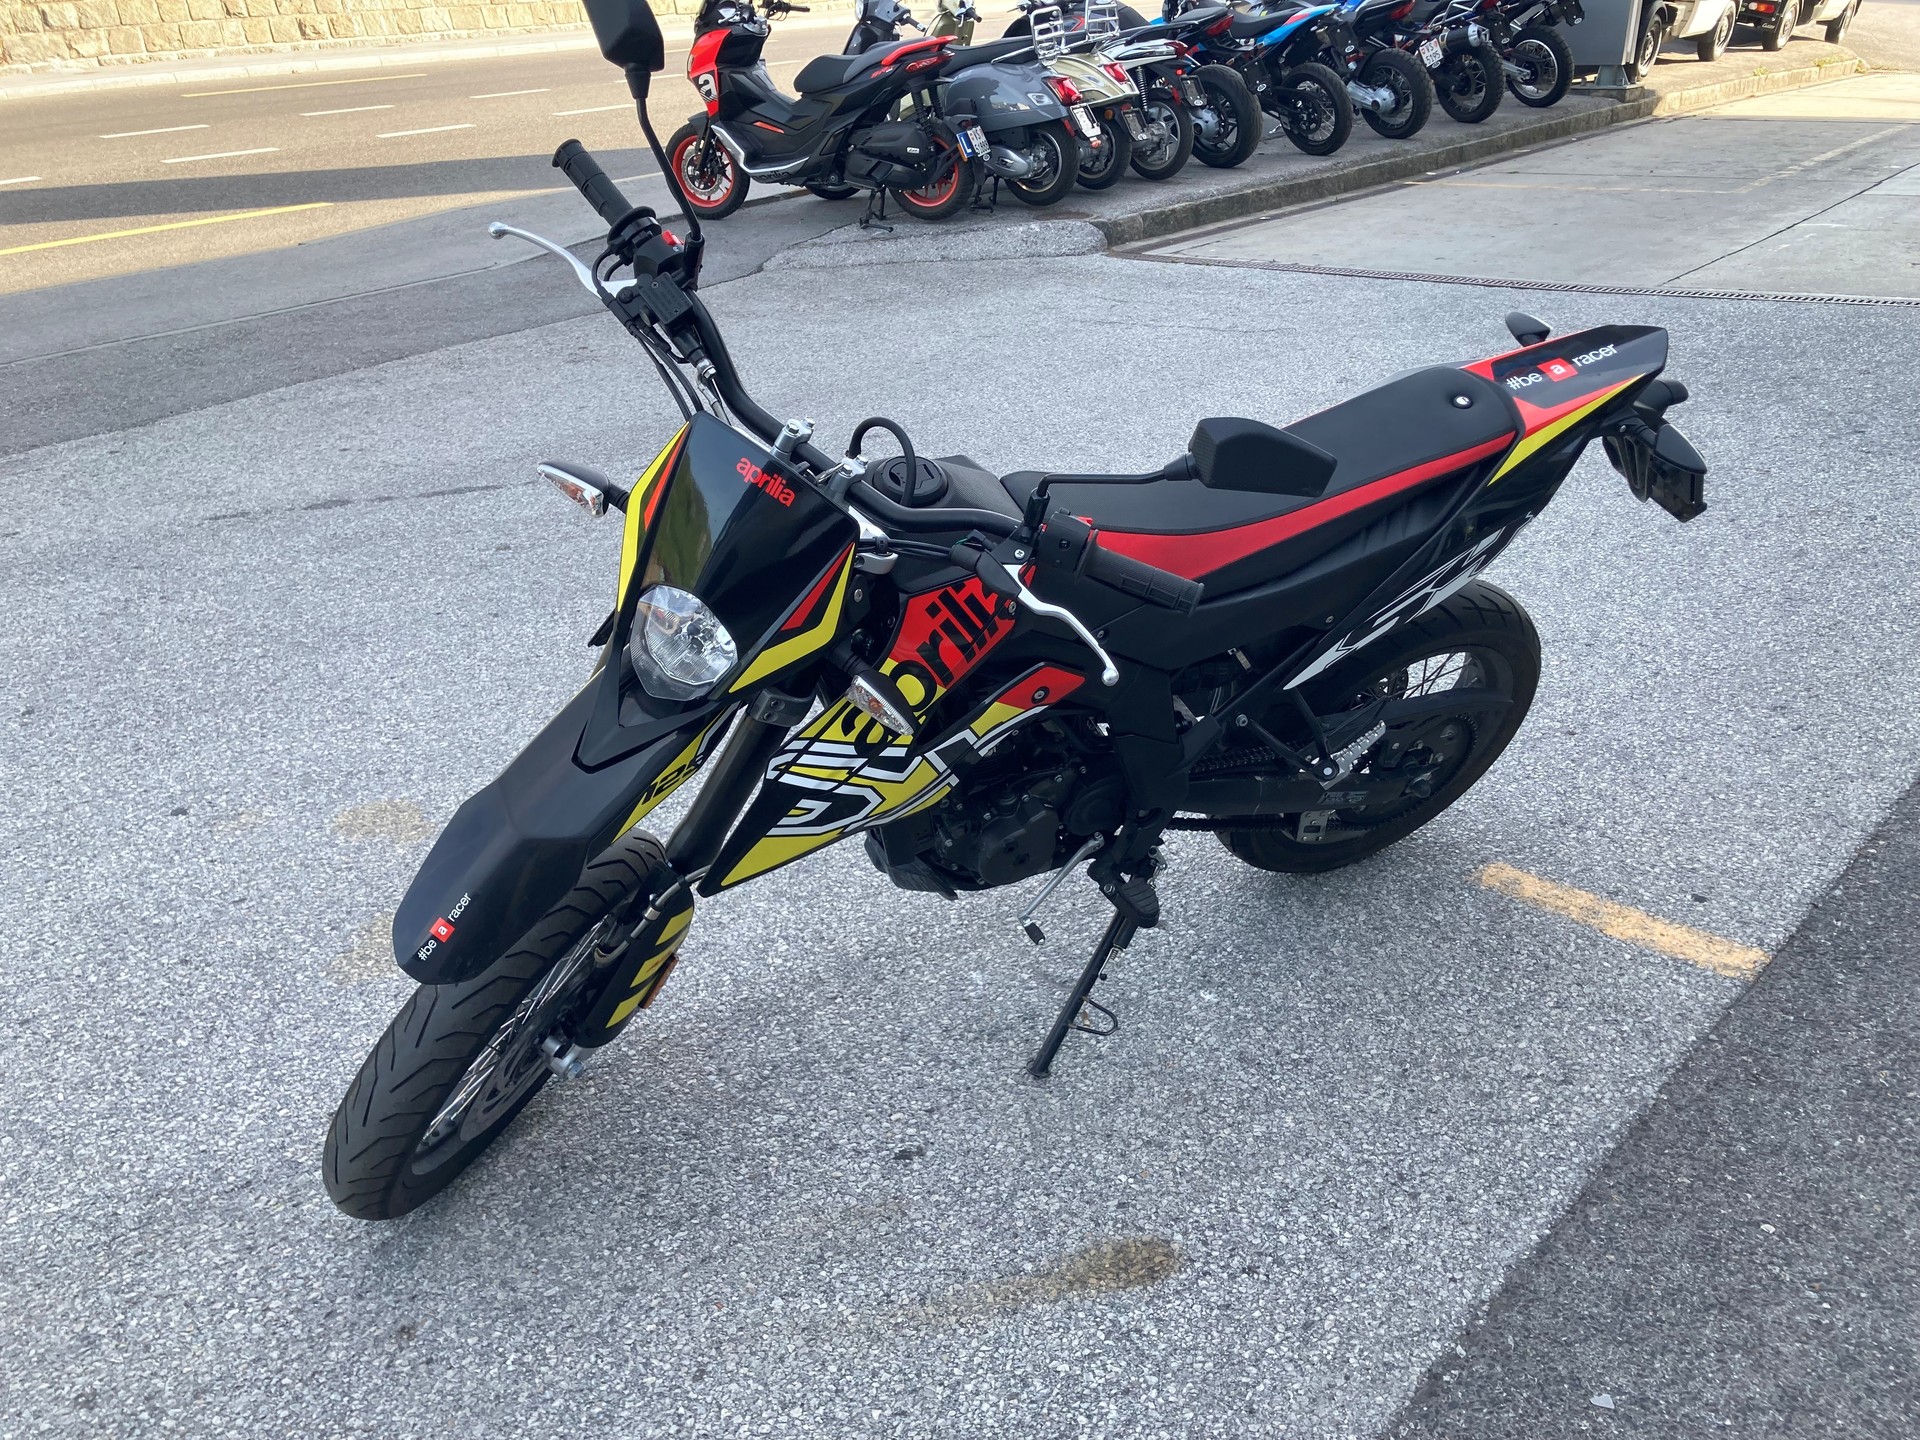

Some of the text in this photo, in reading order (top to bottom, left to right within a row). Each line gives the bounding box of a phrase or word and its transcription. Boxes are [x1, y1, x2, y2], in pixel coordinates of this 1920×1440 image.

[961, 136, 972, 153] L
[1506, 343, 1618, 391] #be a racer
[736, 456, 796, 508] aprilia
[417, 891, 472, 961] #be a racer
